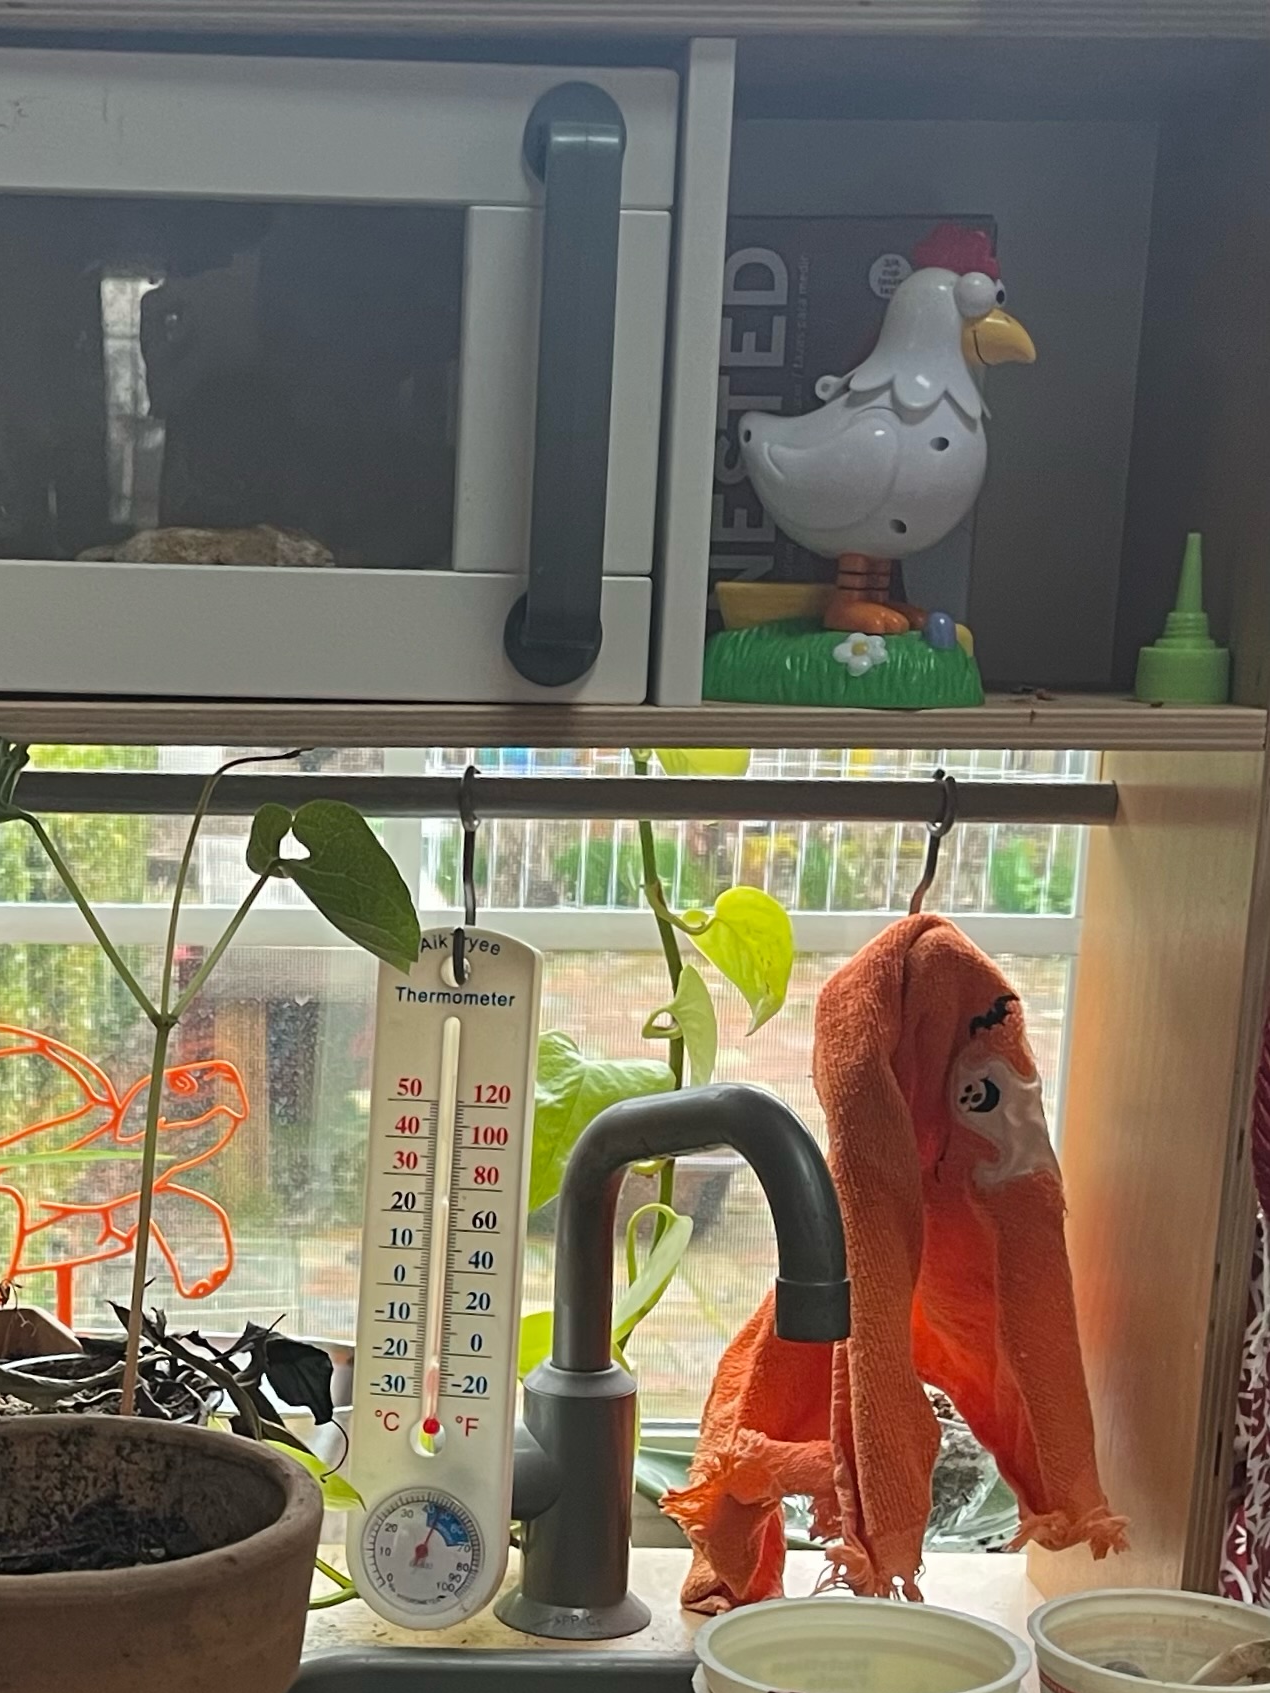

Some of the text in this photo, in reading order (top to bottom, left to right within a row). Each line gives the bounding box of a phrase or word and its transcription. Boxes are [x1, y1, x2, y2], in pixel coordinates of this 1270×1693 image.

[420, 932, 501, 956] Aikyee
[395, 987, 516, 1007] Thermometer
[397, 1078, 422, 1097] 50
[474, 1084, 511, 1104] 120
[394, 1116, 420, 1135] 40
[471, 1126, 508, 1146] 100
[393, 1151, 418, 1171] 30
[473, 1166, 499, 1185] 80
[391, 1192, 416, 1211] 20
[471, 1211, 497, 1230] 60
[389, 1228, 413, 1247] 10
[468, 1251, 494, 1270] 40
[393, 1265, 406, 1283] 0
[465, 1292, 491, 1311] 20
[470, 1333, 483, 1353] 0
[400, 1508, 414, 1519] 30
[385, 1523, 398, 1533] 20
[379, 1547, 392, 1557] 10
[457, 1542, 471, 1553] 70
[386, 1573, 394, 1582] 0
[436, 1581, 455, 1592] 100
[448, 1573, 462, 1583] 90
